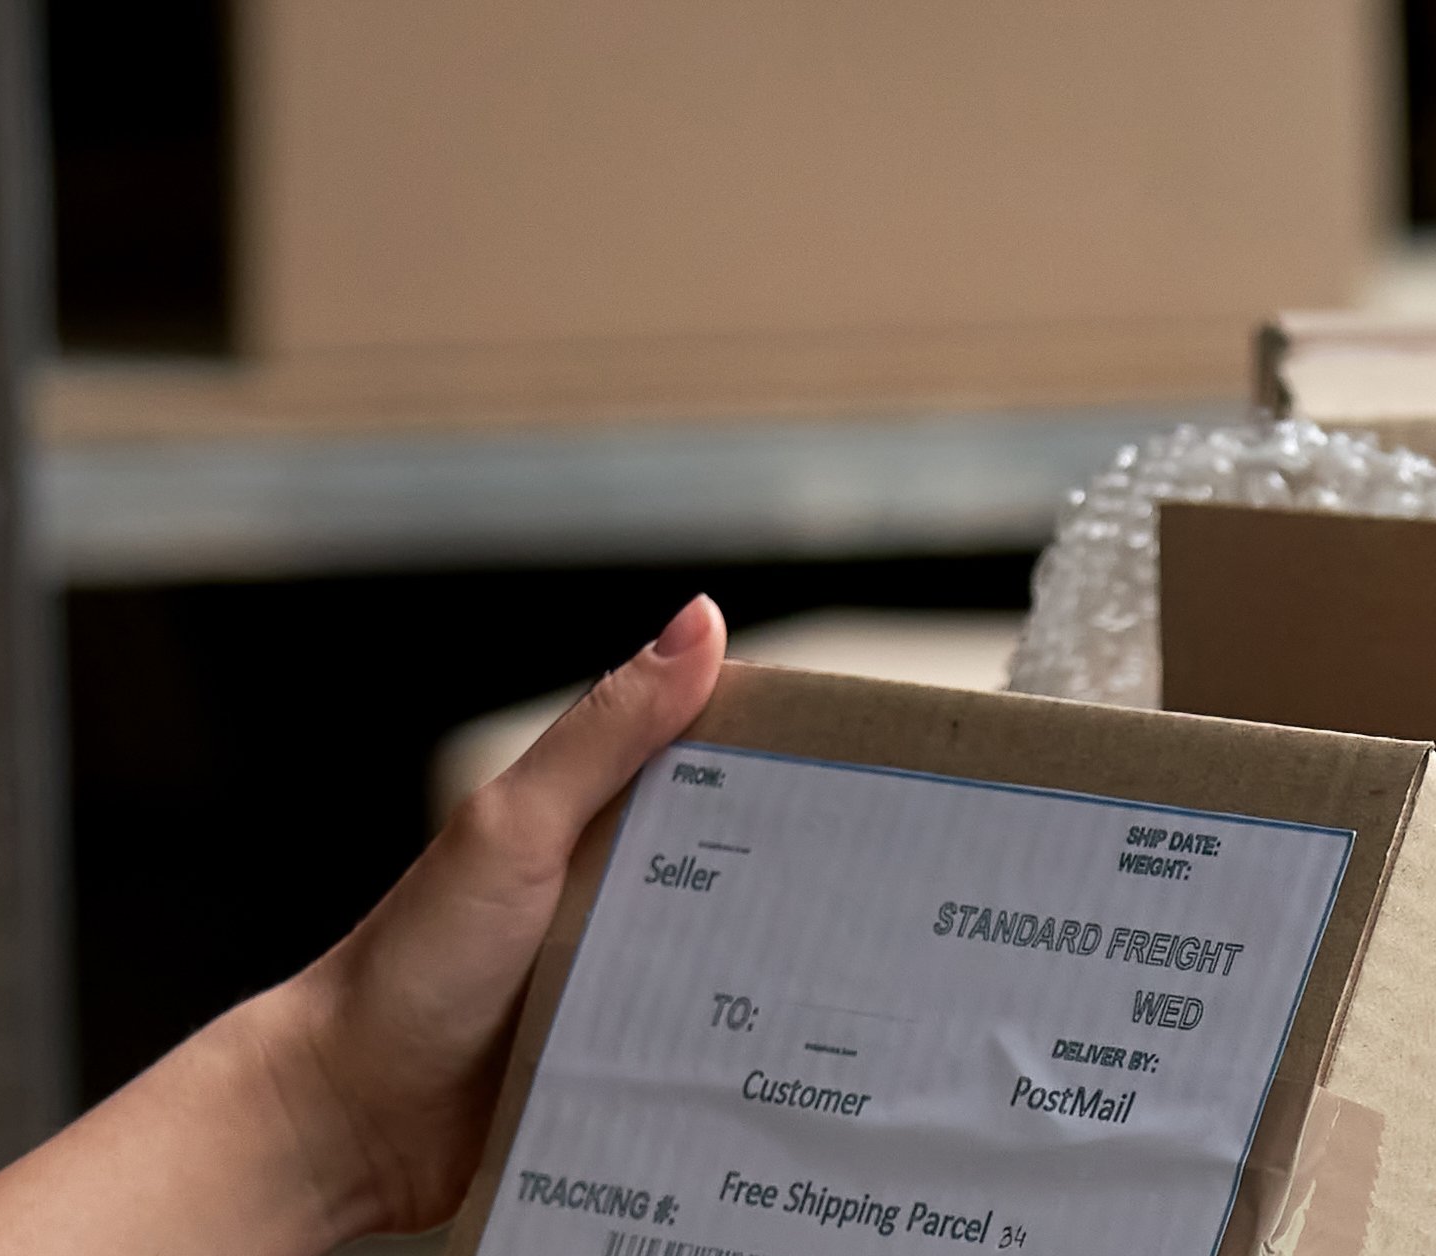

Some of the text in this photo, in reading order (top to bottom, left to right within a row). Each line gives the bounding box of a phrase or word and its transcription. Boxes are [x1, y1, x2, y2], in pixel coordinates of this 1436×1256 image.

[672, 761, 726, 788] FROM:
[1126, 825, 1221, 857] SHIP DATE:
[644, 853, 721, 892] Seller
[1118, 852, 1192, 881] WEIGHT:
[932, 901, 1245, 977] STANDARD FREIGHT
[711, 992, 760, 1033] TO:
[1131, 990, 1205, 1031] WED
[1052, 1038, 1160, 1073] DELIVER BY:
[741, 1069, 872, 1117] Customer
[1010, 1075, 1137, 1124] PostMail
[517, 1169, 682, 1227] TRACKING #:
[718, 1170, 994, 1245] Free Shipping Parcel
[997, 1224, 1028, 1250] 34
